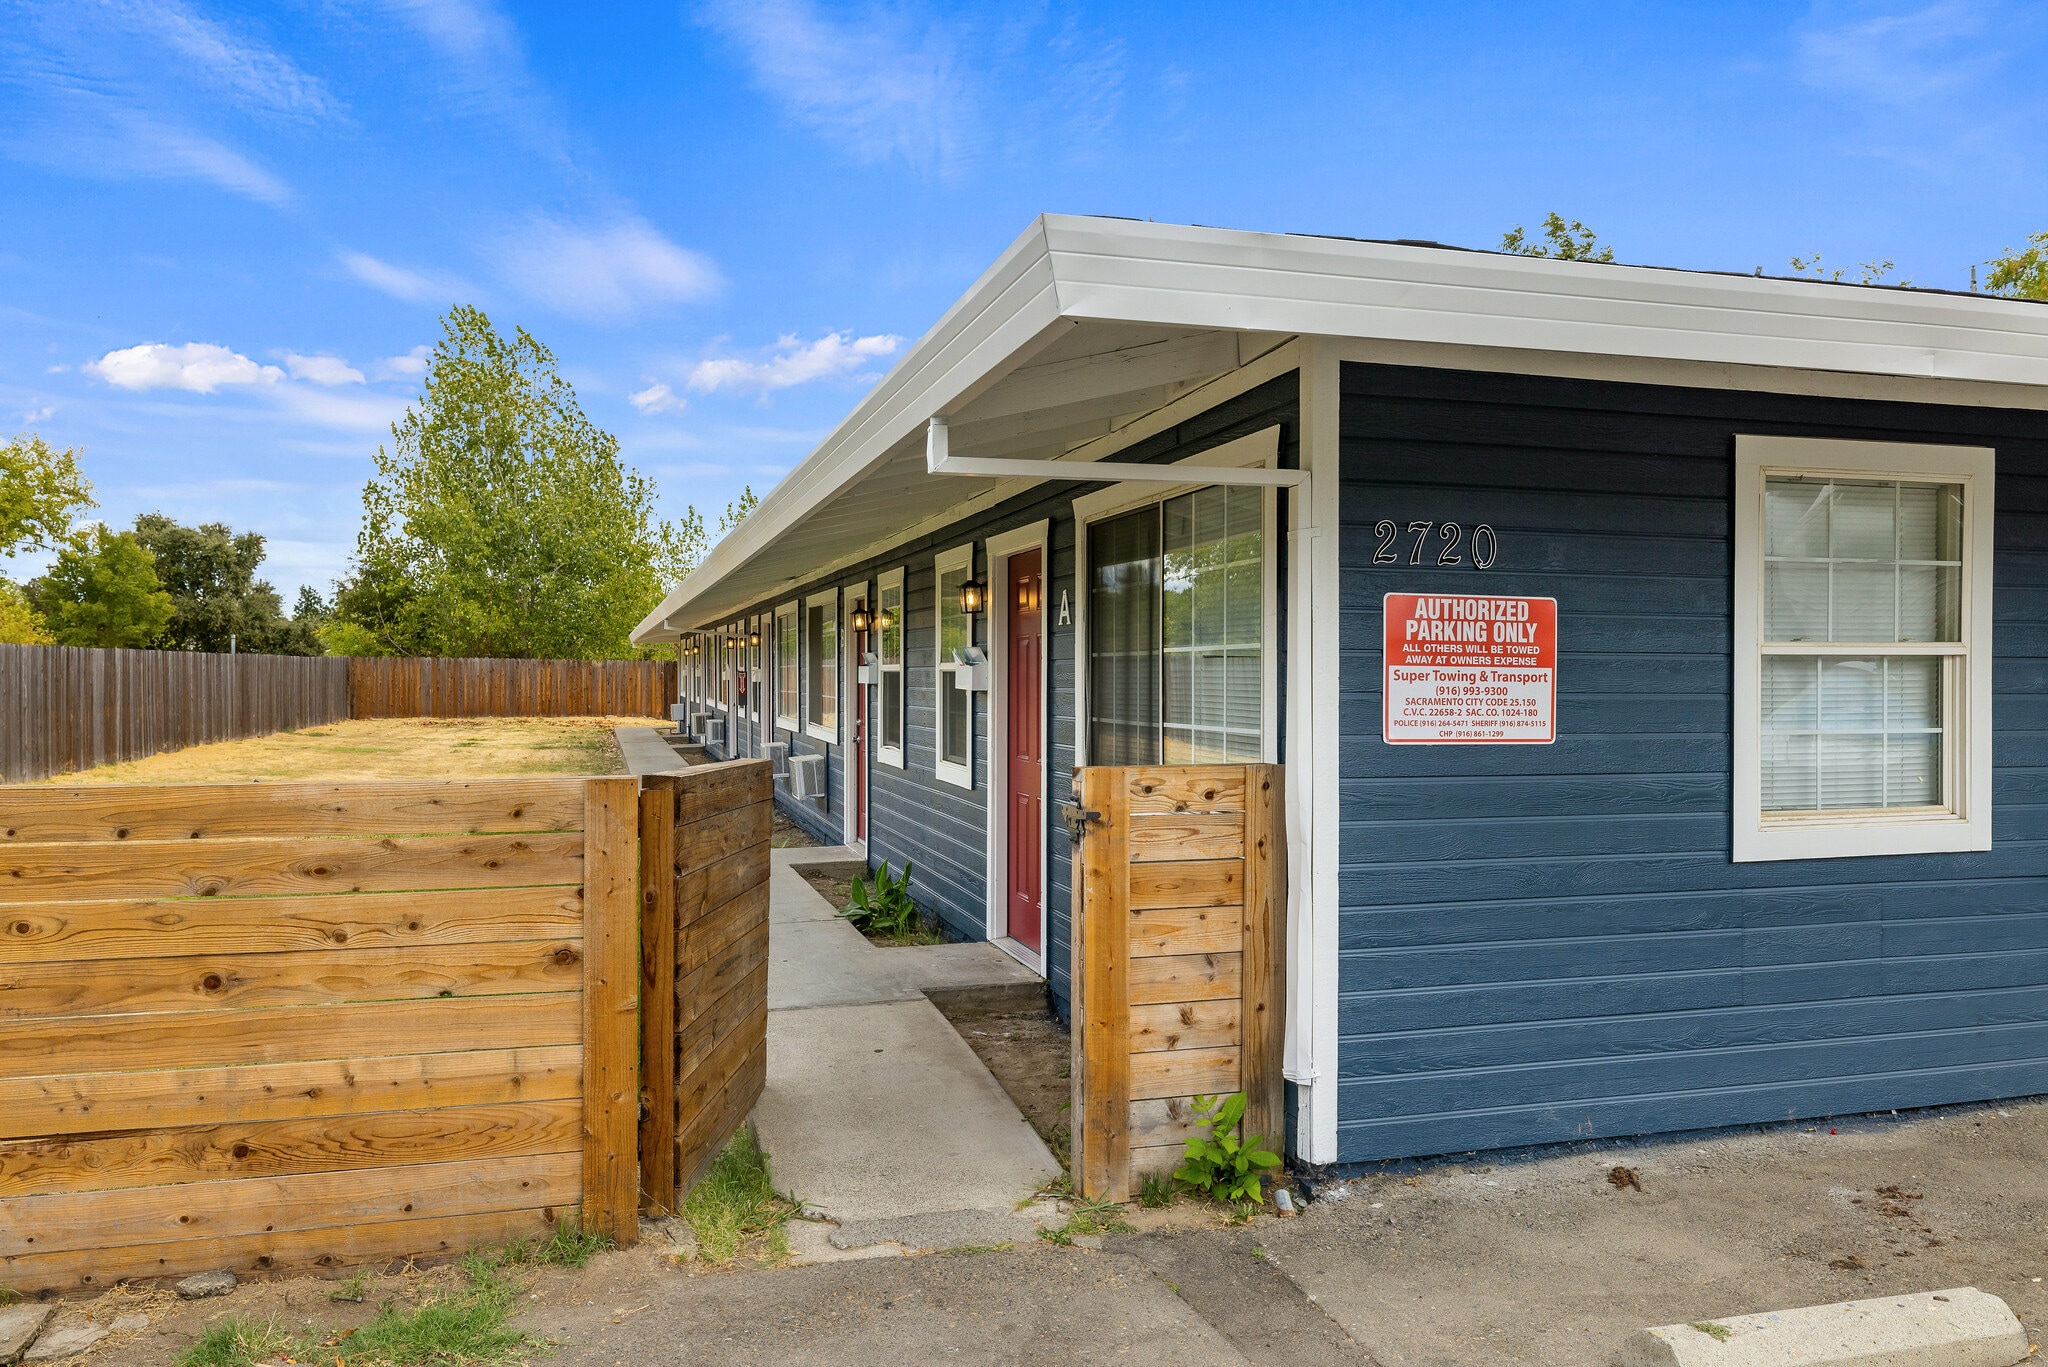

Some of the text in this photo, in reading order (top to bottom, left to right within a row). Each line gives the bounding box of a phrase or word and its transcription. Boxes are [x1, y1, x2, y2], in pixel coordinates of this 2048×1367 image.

[1373, 519, 1497, 569] 2720
[1058, 589, 1071, 626] A
[1414, 597, 1529, 622] AUTHORIZED
[1406, 619, 1538, 643] PARKING ONLY
[1402, 643, 1540, 655] ALL OTHERS WILL BE TOWED
[1405, 655, 1537, 666] AWAY AT OWNERS EXPENSE
[1393, 669, 1548, 686] Super Towing & Transport
[1435, 686, 1508, 697] (916) 993-9300
[1405, 697, 1537, 707] SACRAMENTO CITY CODE 25.150
[1403, 708, 1538, 717] C.V.C. 22658-2 SAC. CO. 1024-180
[1393, 719, 1419, 727] POLICE
[1420, 720, 1437, 728] (916)
[1499, 720, 1516, 728] (916)
[1455, 730, 1473, 738] (916)
